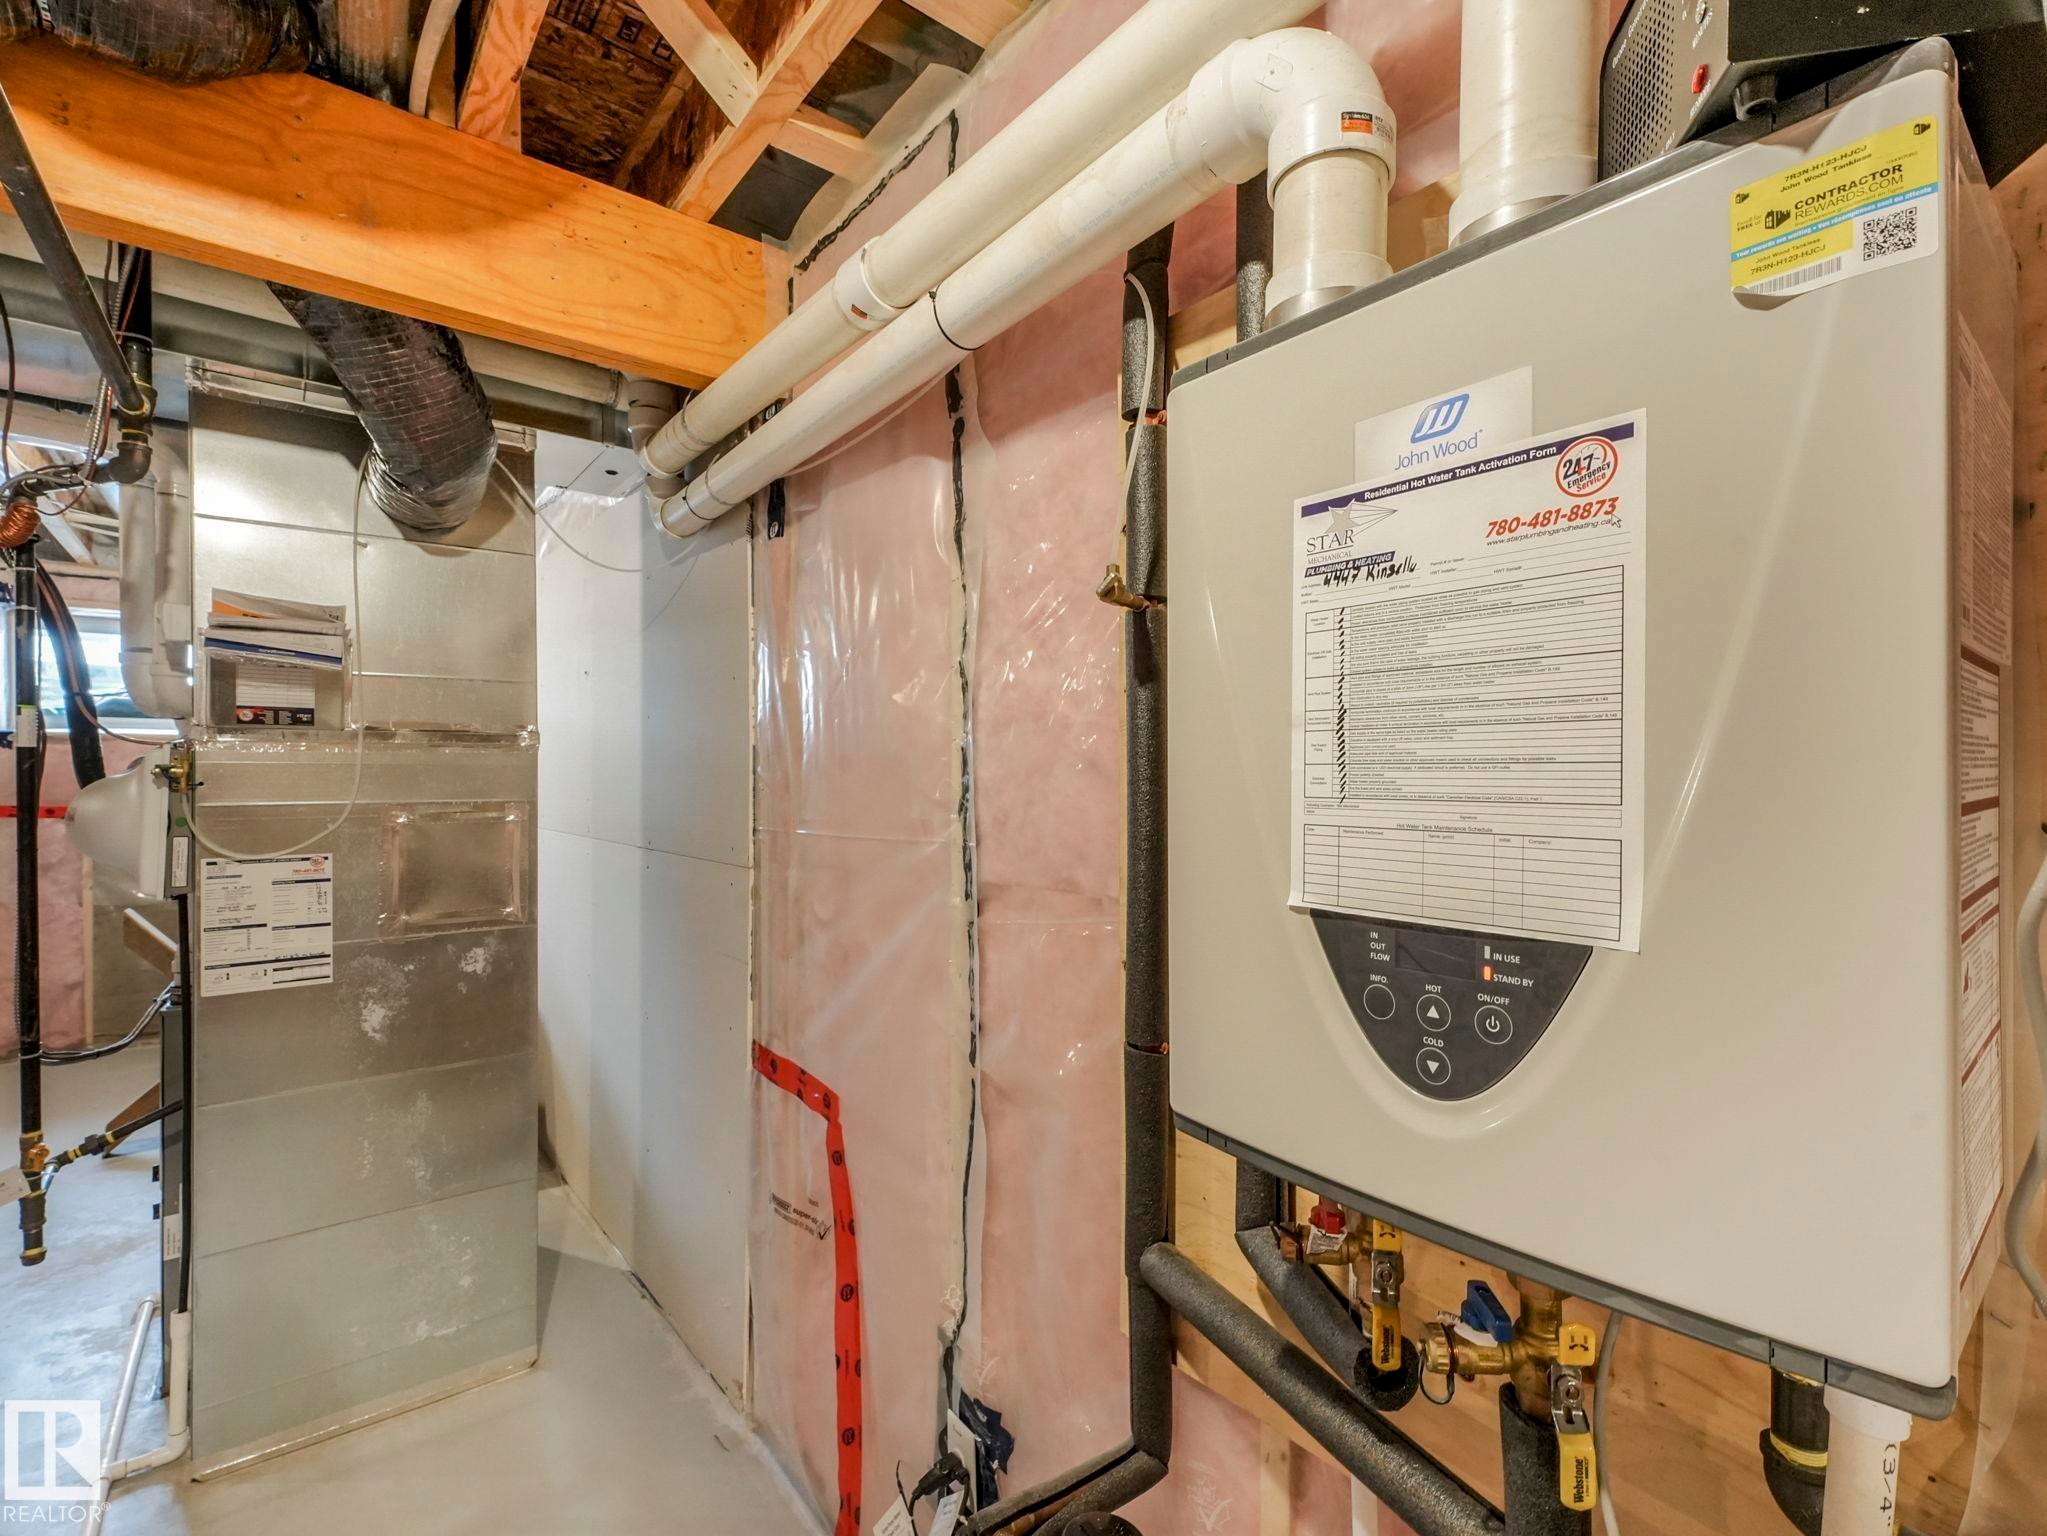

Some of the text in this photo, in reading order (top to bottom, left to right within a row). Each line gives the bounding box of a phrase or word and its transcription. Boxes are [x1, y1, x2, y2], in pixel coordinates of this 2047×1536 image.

[1780, 180, 1801, 193] John
[1803, 170, 1829, 184] Wood
[1831, 153, 1873, 172] Tankless
[1794, 163, 1903, 211] CONTRACTOR
[1794, 175, 1904, 221] REWARDS.COM
[1394, 431, 1479, 470] John Wood
[1364, 445, 1557, 500] Residential Hot Water Tank Activation Form
[1566, 461, 1612, 490] Emergency
[1576, 472, 1607, 493] Service
[1485, 496, 1620, 539] 780-481-8873
[1306, 528, 1355, 553] STAR
[1306, 560, 1346, 577] PLUMBING
[1354, 552, 1393, 568] HEATING
[1307, 551, 1351, 566] MECHANICAL
[1370, 931, 1378, 939] IN
[1370, 942, 1386, 950] OUT
[1370, 952, 1390, 962] FLOW
[1493, 953, 1521, 964] IN USE
[1370, 973, 1389, 984] INFO.
[1425, 984, 1442, 993] HOT
[1493, 973, 1534, 987] STAND BY
[1477, 993, 1511, 1006] ON/OFF
[1423, 1036, 1444, 1047] COLD
[1381, 1326, 1391, 1365] Webstone
[1573, 1457, 1584, 1504] Webstone
